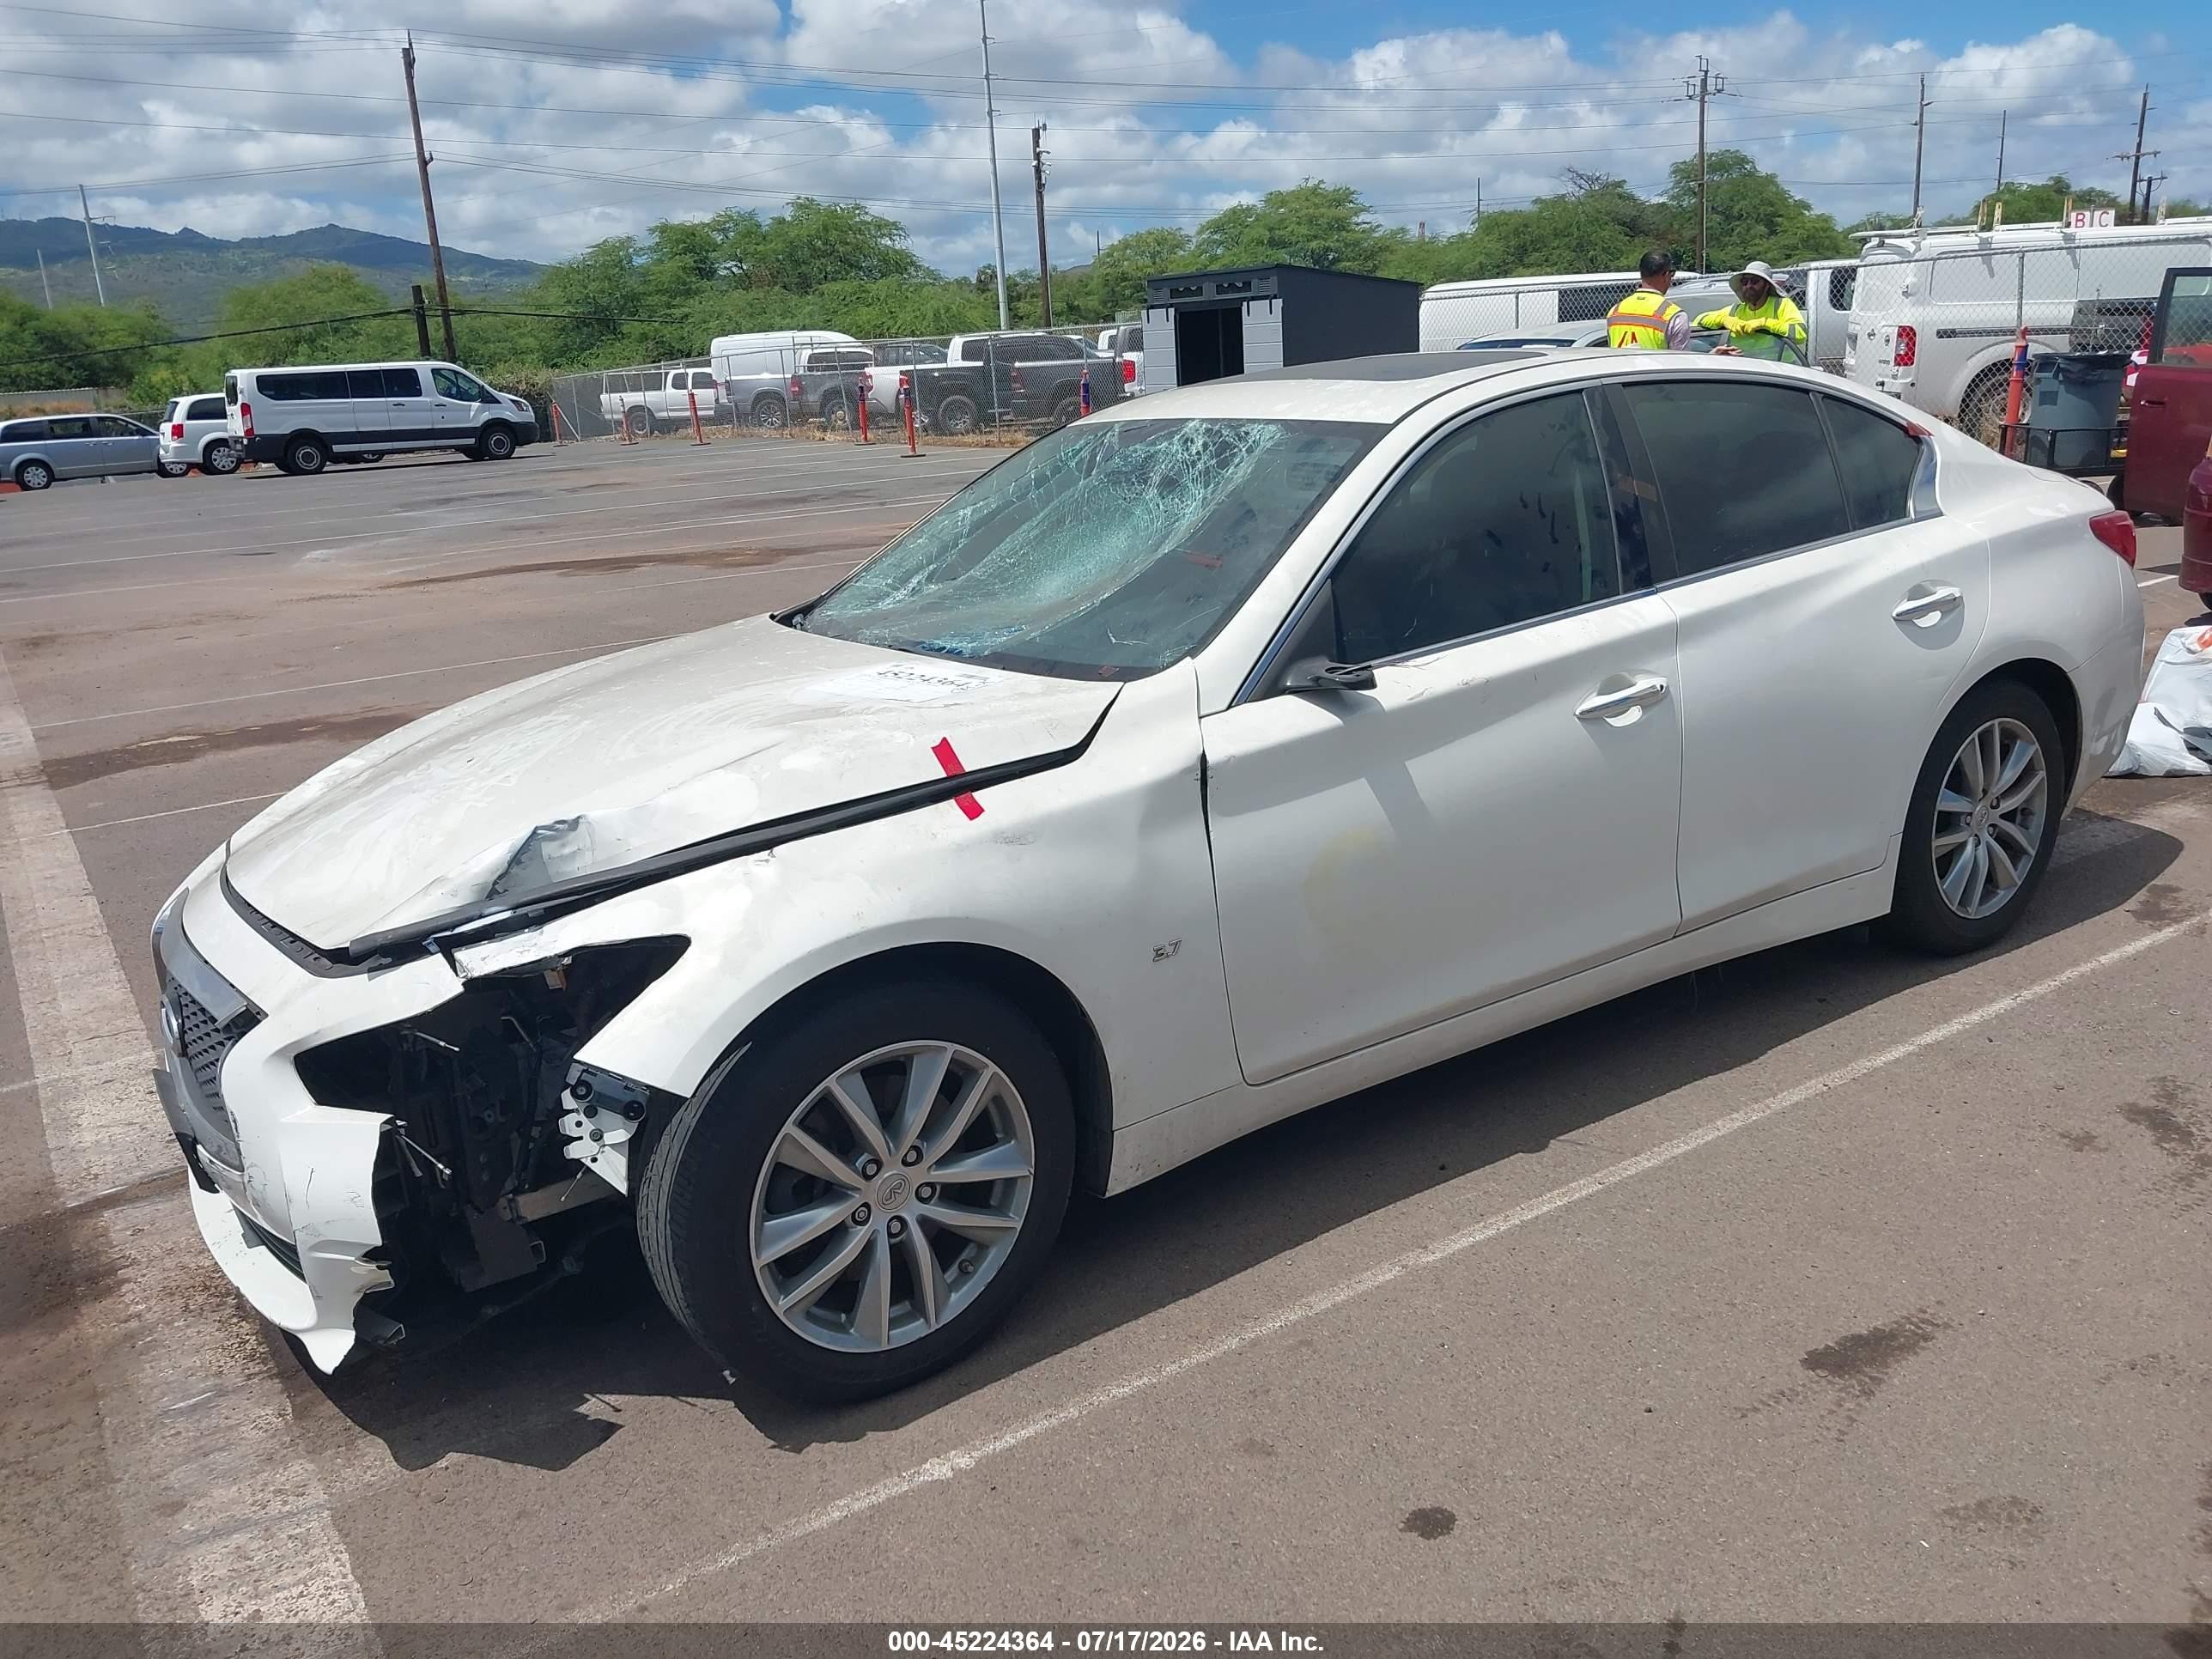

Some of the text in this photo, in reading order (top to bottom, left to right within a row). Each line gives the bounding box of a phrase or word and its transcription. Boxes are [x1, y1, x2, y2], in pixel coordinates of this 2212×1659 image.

[2074, 210, 2110, 228] B C
[1152, 938, 1182, 962] 3.7
